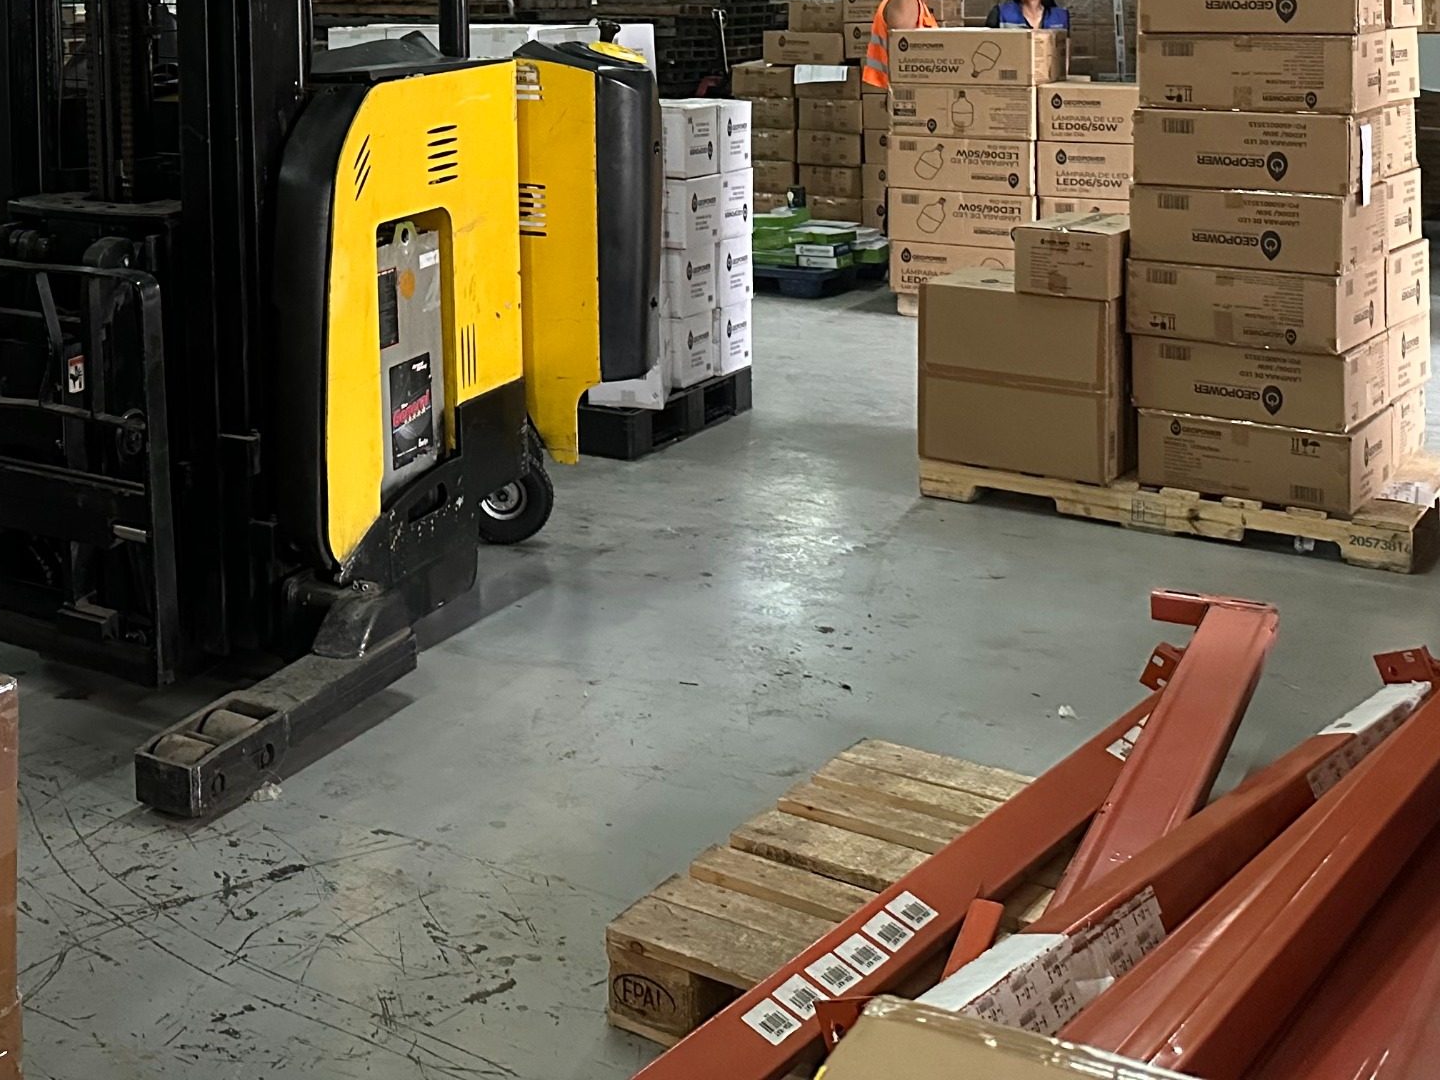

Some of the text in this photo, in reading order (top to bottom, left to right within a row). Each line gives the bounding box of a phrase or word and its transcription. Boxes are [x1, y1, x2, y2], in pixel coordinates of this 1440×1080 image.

[1206, 0, 1274, 10] GEOPOWER
[898, 65, 959, 74] LED06/50W
[1262, 94, 1304, 102] GEOPOWER
[1051, 123, 1118, 132] LED06/50W
[956, 149, 1019, 160] LED06/50W
[1197, 154, 1265, 166] GEOPOWER
[1056, 178, 1122, 188] LED06/50W
[958, 204, 1021, 215] LED06/50W
[1192, 232, 1259, 246] GEOPOWER
[1195, 384, 1260, 400] GEOPOWER
